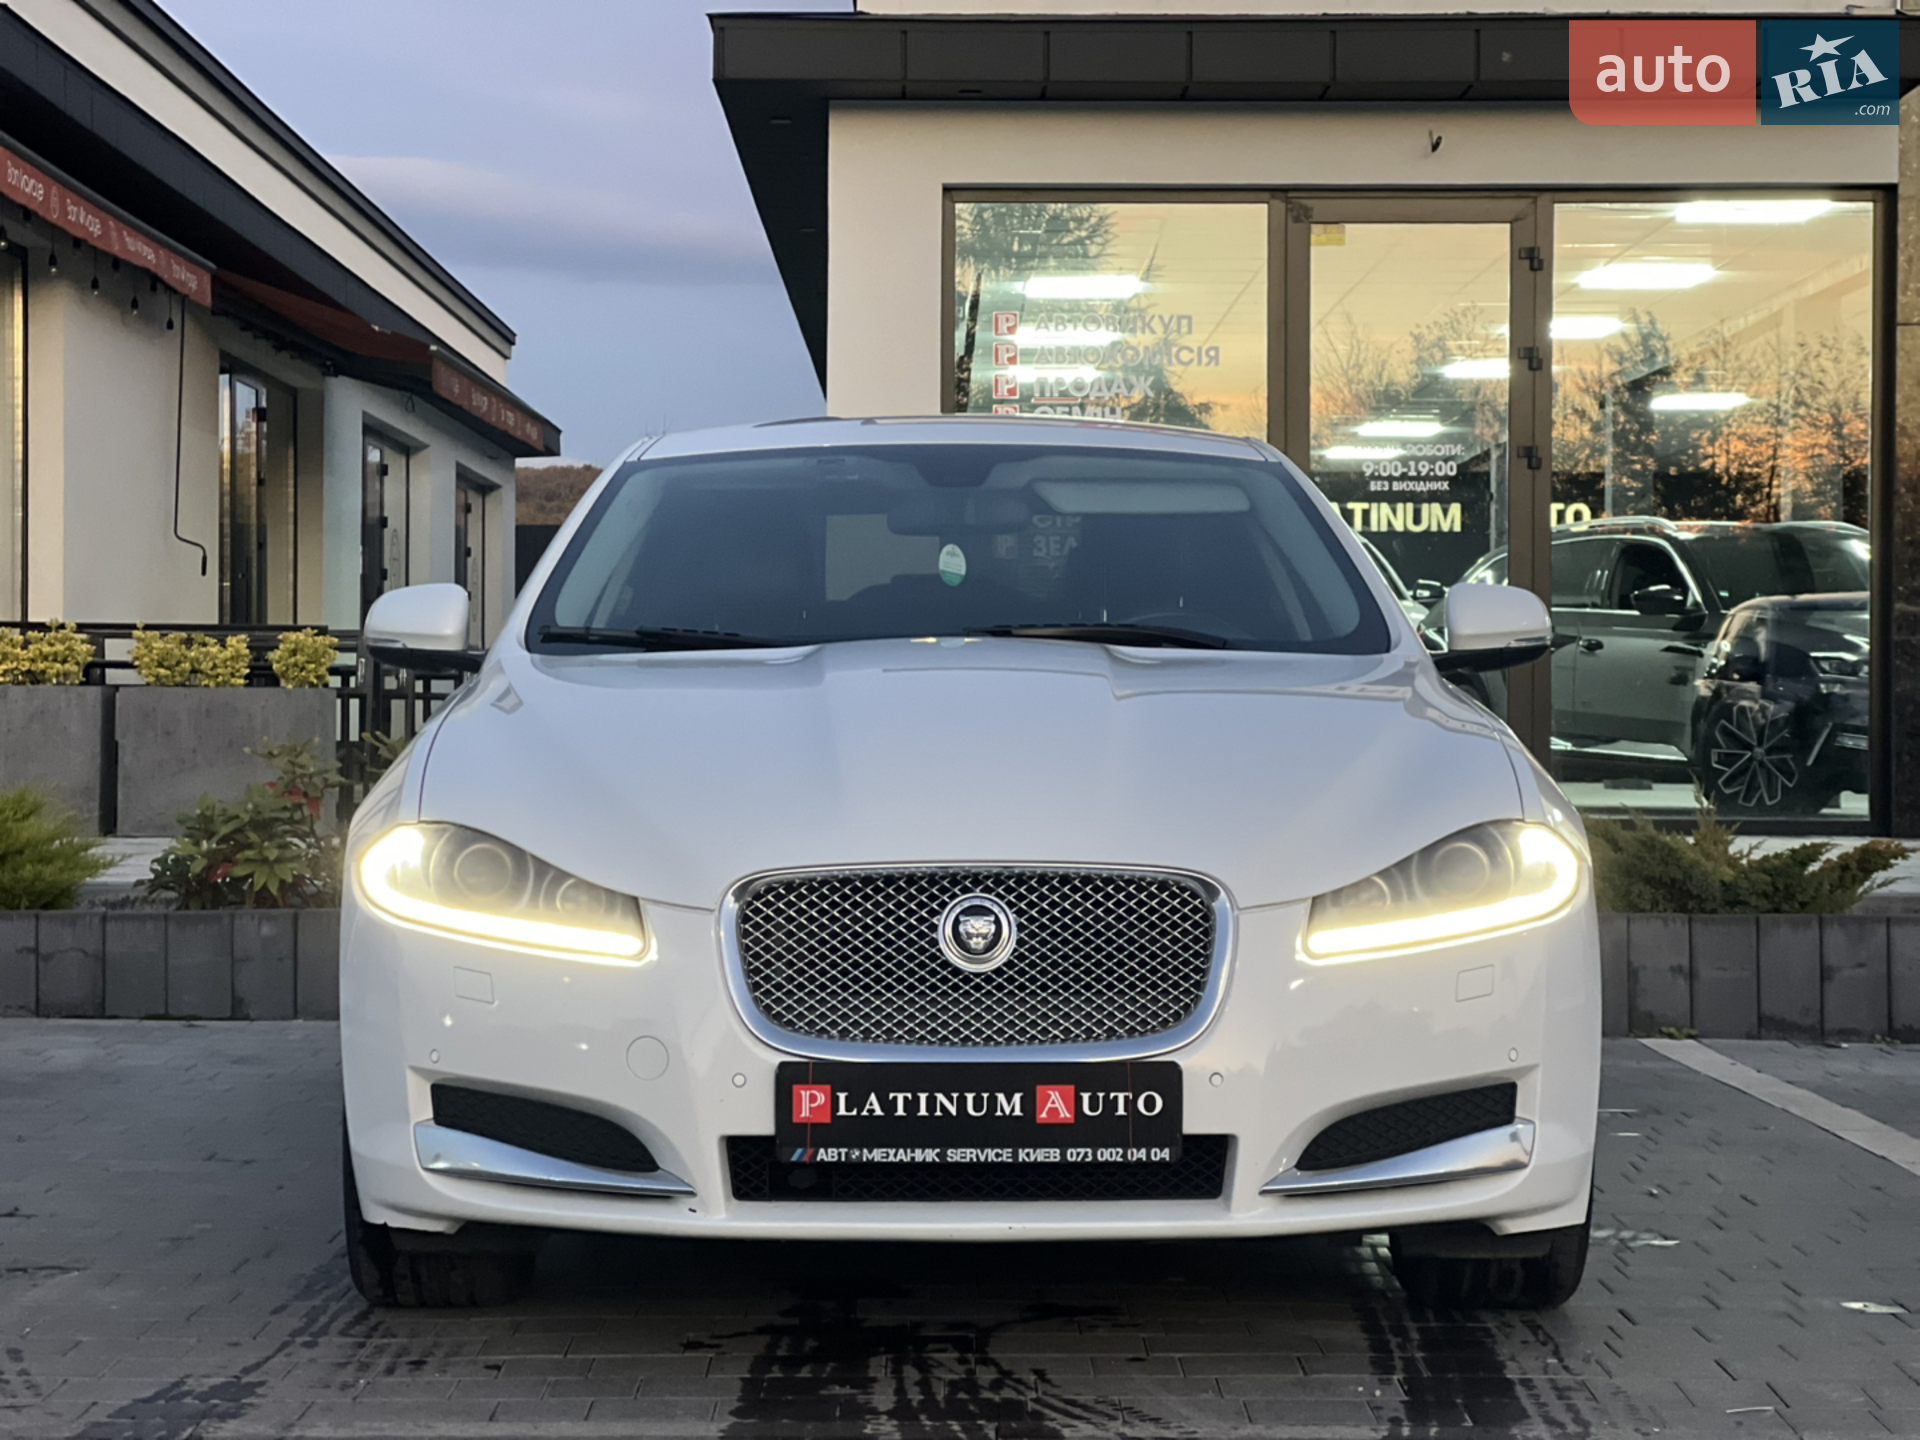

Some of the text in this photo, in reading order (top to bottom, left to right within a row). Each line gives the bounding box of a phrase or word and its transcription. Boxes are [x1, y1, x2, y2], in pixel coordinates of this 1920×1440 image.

[1034, 313, 1194, 335] АВТОВИКУП
[1034, 345, 1221, 367] АВТОКОМІСІЯ
[1032, 376, 1155, 399] ПРОДАЖ
[1362, 461, 1457, 476] 9:00-19:00
[1370, 481, 1450, 492] БЕЗ ВИХІДНИХ
[1331, 502, 1462, 532] TINUM
[799, 1089, 1164, 1118] PLATINUM AUTO
[946, 1148, 1013, 1162] SERVICE
[1018, 1148, 1061, 1162] КИЕВ
[1066, 1149, 1093, 1162] 073
[1097, 1149, 1123, 1162] 002
[1127, 1149, 1147, 1162] 04
[1150, 1149, 1170, 1162] 04
